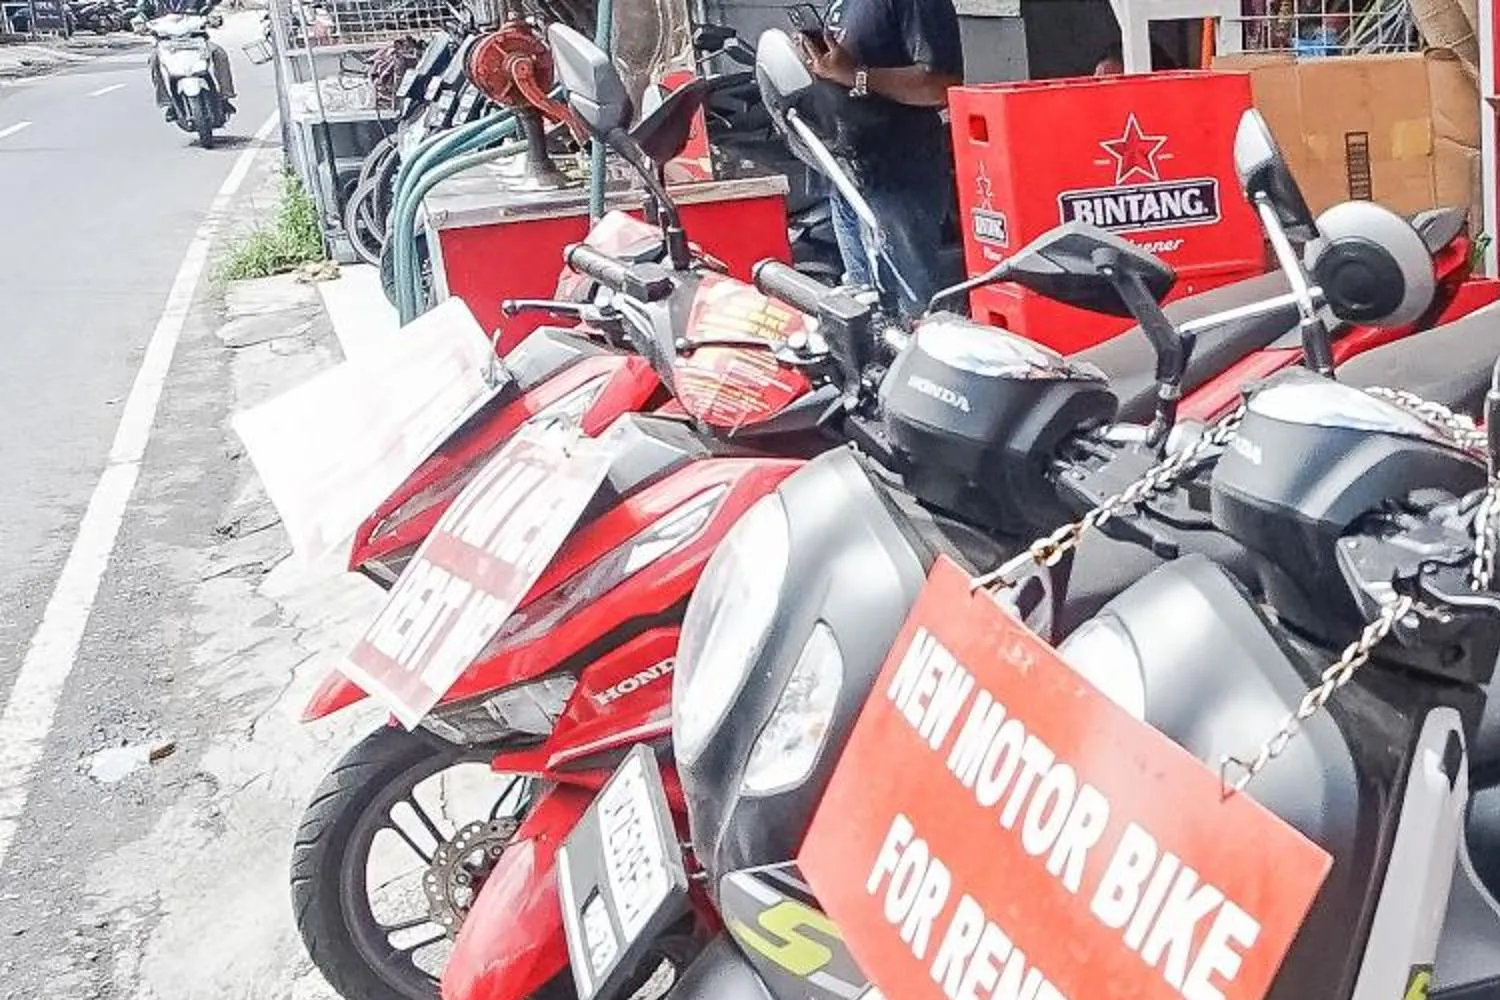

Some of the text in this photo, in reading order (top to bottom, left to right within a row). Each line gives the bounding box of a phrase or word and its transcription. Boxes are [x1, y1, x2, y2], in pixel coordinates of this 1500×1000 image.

[1072, 188, 1203, 228] BINTANG
[908, 375, 971, 413] HONDA
[592, 656, 677, 705] HOND
[886, 625, 975, 751] NEW
[955, 691, 1111, 892] MOTOR
[866, 812, 953, 960] FOR
